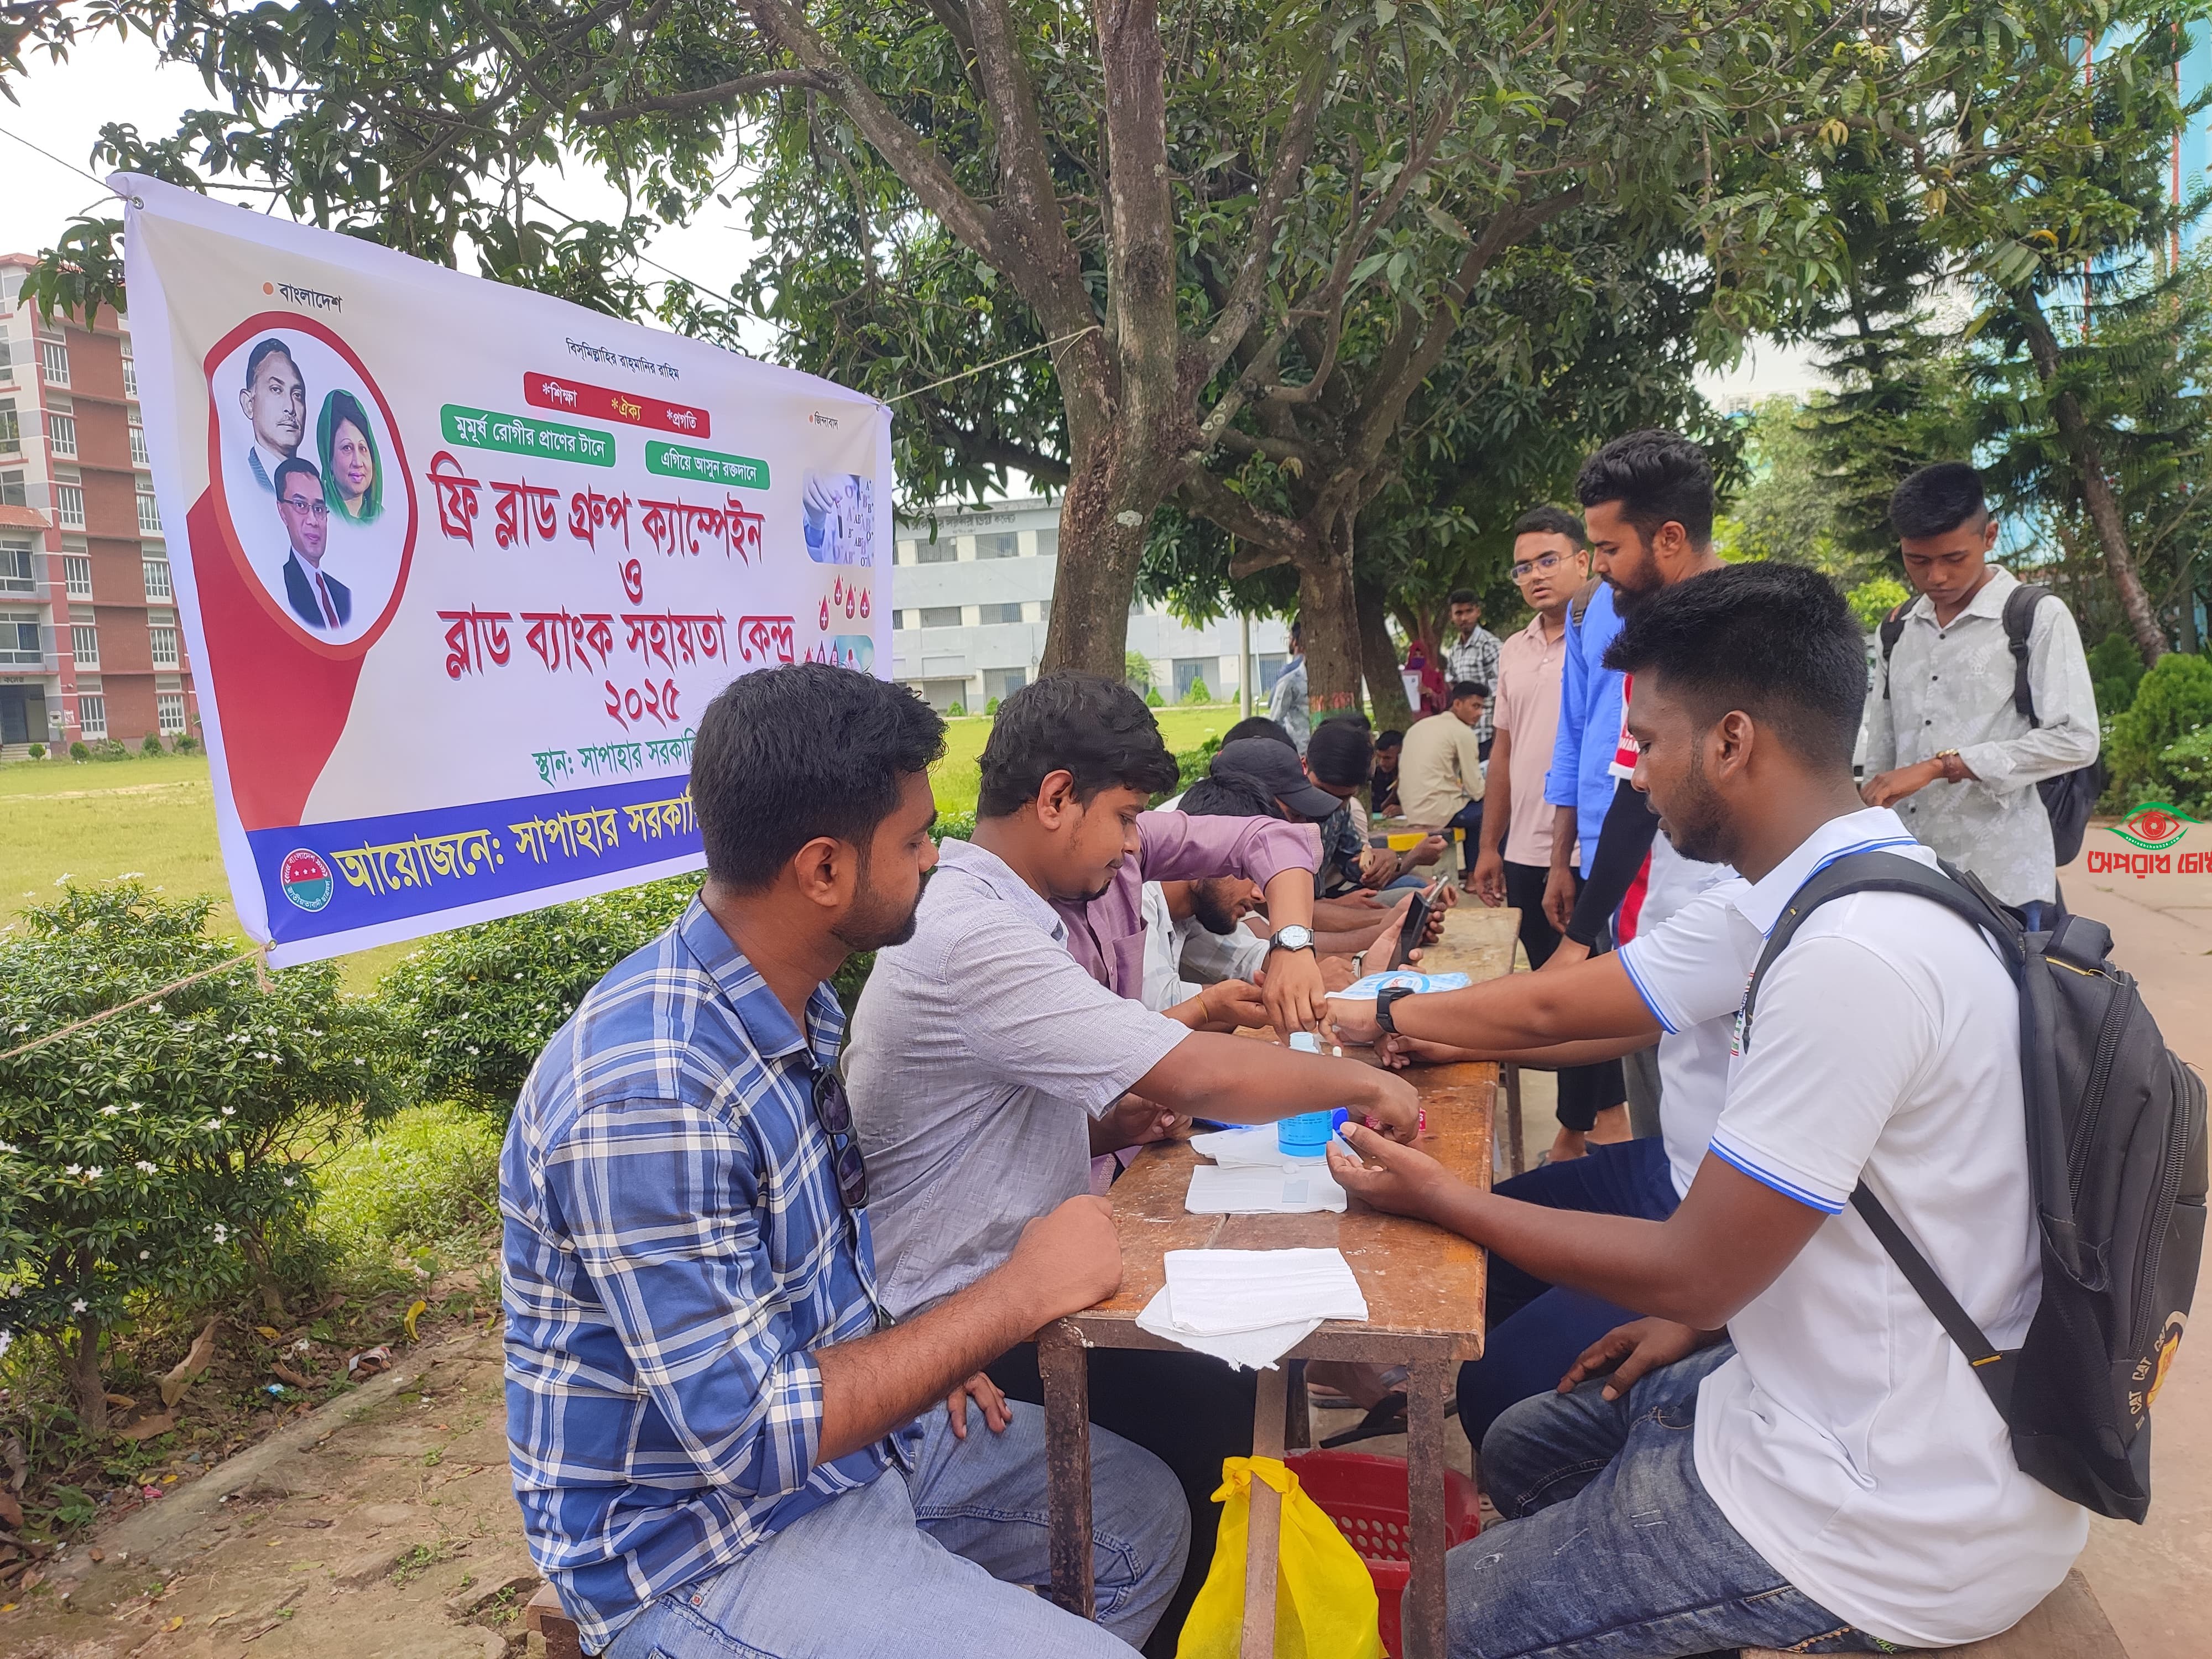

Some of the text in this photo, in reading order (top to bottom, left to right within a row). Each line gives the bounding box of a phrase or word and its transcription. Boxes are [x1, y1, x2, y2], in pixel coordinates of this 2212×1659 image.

[278, 283, 342, 313] বাংলাদেশ
[656, 363, 680, 381] রাহিম
[493, 419, 535, 447] রোগীর
[539, 429, 576, 453] প্রাণের
[578, 431, 606, 458] টানে
[814, 411, 838, 430] জিন্দাবাদ
[661, 447, 757, 483] এগিয়ে আসুন রক্তদানে
[425, 450, 766, 569] ফ্রি ব্লাড গ্রুপ ক্যাম্পেইন
[618, 559, 643, 606] ও
[436, 601, 796, 681] ব্লাড ব্যাংক সহায়তা কেন্দ্র
[604, 678, 681, 734] ২০২৫
[532, 747, 574, 789] স্থান:
[577, 739, 643, 777] সাপাহার
[288, 852, 315, 864] বাংলাদেশ
[330, 833, 504, 896] আয়োজনে:
[508, 805, 619, 865] সাপাহার
[2132, 1356, 2152, 1381] CAT
[2128, 1391, 2142, 1415] CAT
